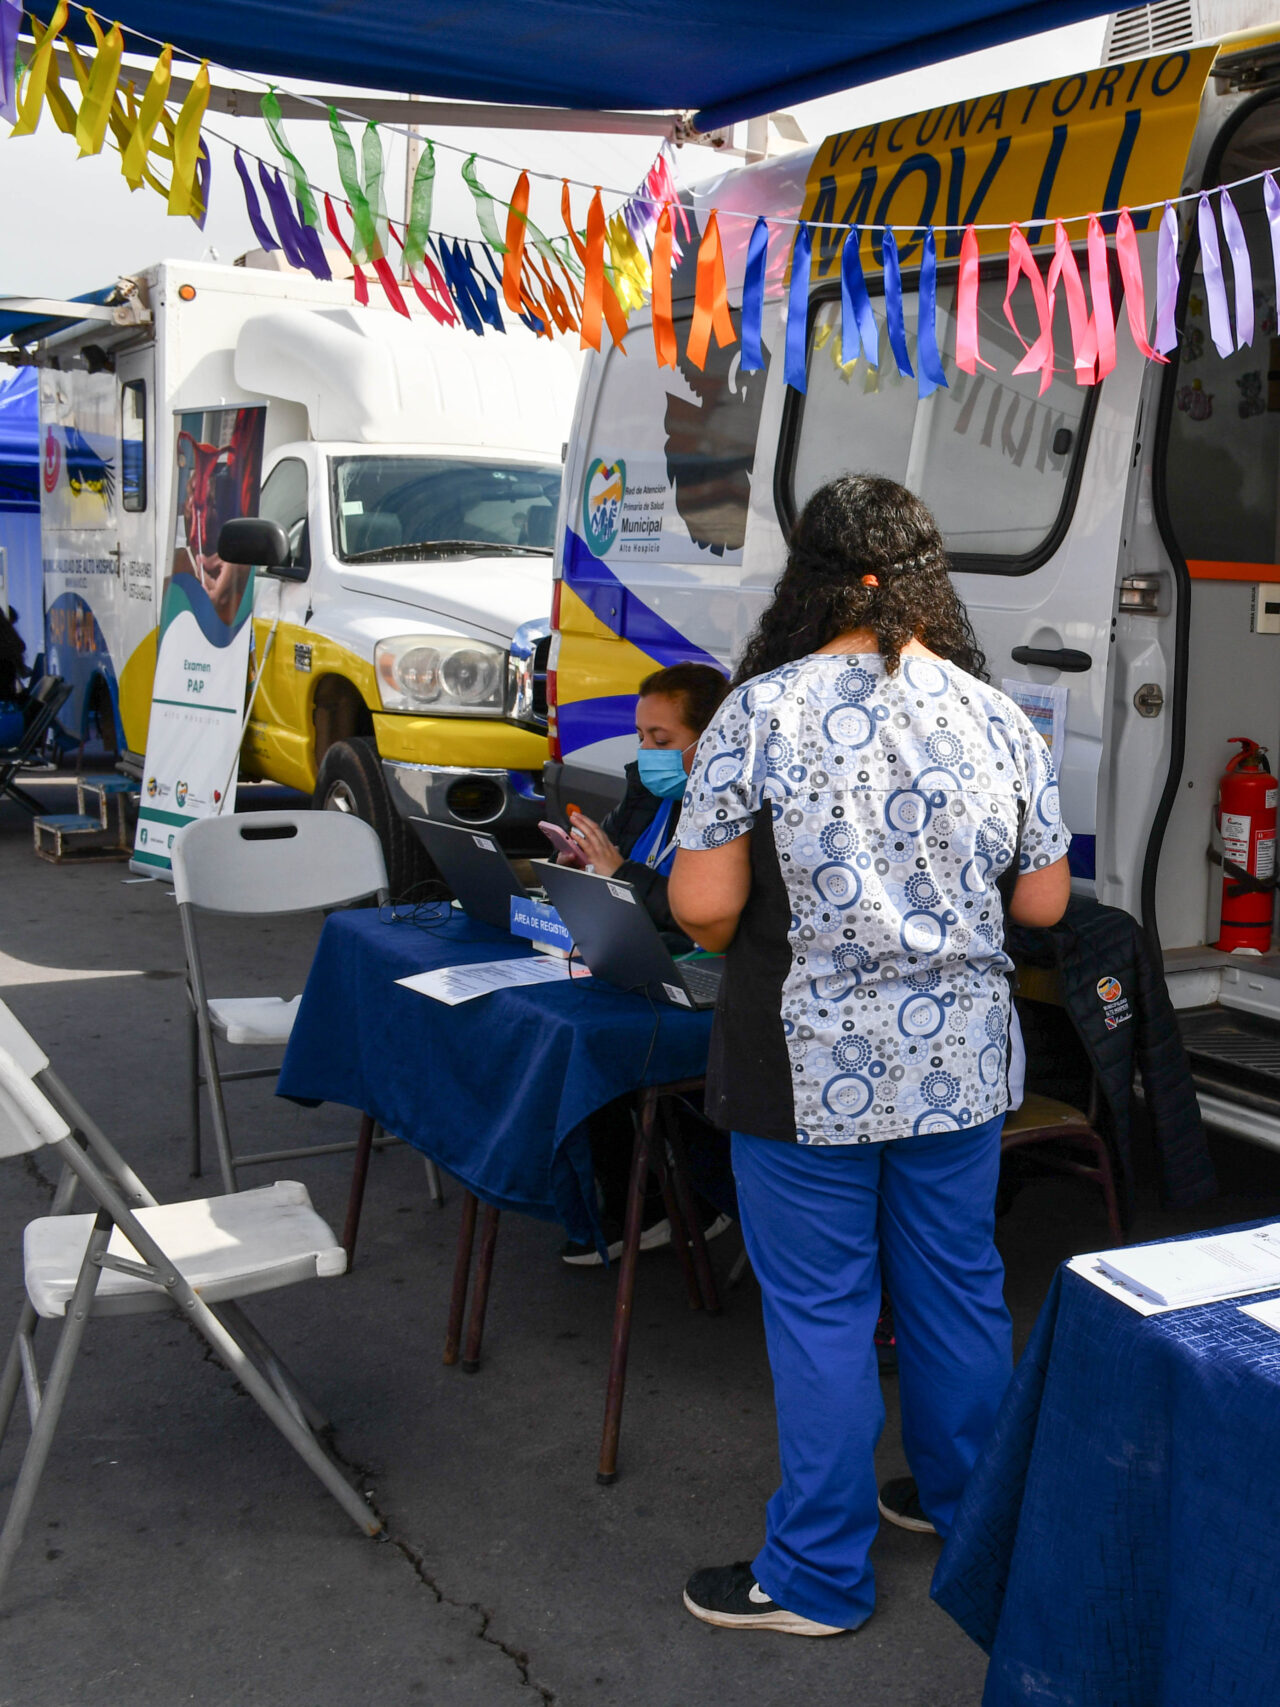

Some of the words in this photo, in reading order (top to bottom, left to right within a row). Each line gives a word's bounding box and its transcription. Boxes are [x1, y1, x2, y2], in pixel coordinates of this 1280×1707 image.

[829, 50, 1190, 167] VACUNATORIO
[806, 109, 1152, 277] MOVIL
[644, 484, 666, 494] Atención
[623, 502, 642, 511] Primaria
[643, 502, 649, 510] de
[650, 501, 664, 510] Salud
[621, 516, 662, 536] Municipal
[619, 543, 631, 552] Alto
[633, 543, 660, 554] Hospicio
[184, 659, 211, 673] Examen
[187, 679, 204, 693] PAP
[514, 910, 530, 925] ÁREA
[531, 916, 539, 928] DE
[540, 920, 569, 938] REGISTRO
